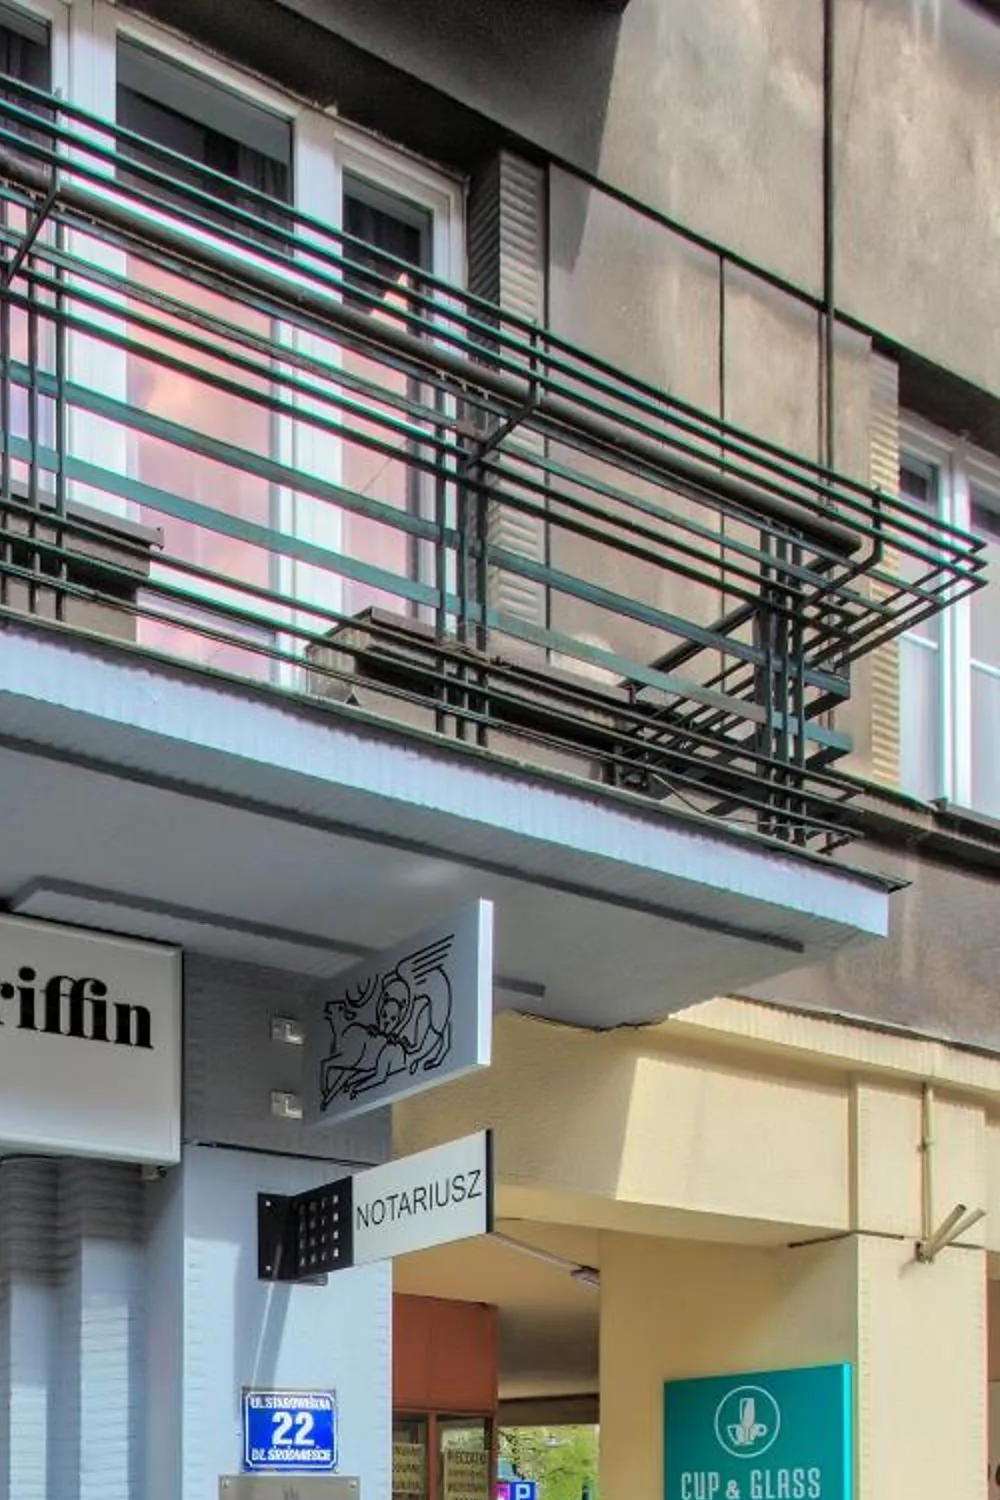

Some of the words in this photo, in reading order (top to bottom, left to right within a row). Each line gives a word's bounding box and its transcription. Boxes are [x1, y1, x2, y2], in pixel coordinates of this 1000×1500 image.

[356, 1169, 482, 1230] NOTARIUSZ
[272, 1411, 315, 1445] 22
[680, 1471, 719, 1500] CUP
[726, 1480, 740, 1500] &
[751, 1467, 821, 1500] GLASS
